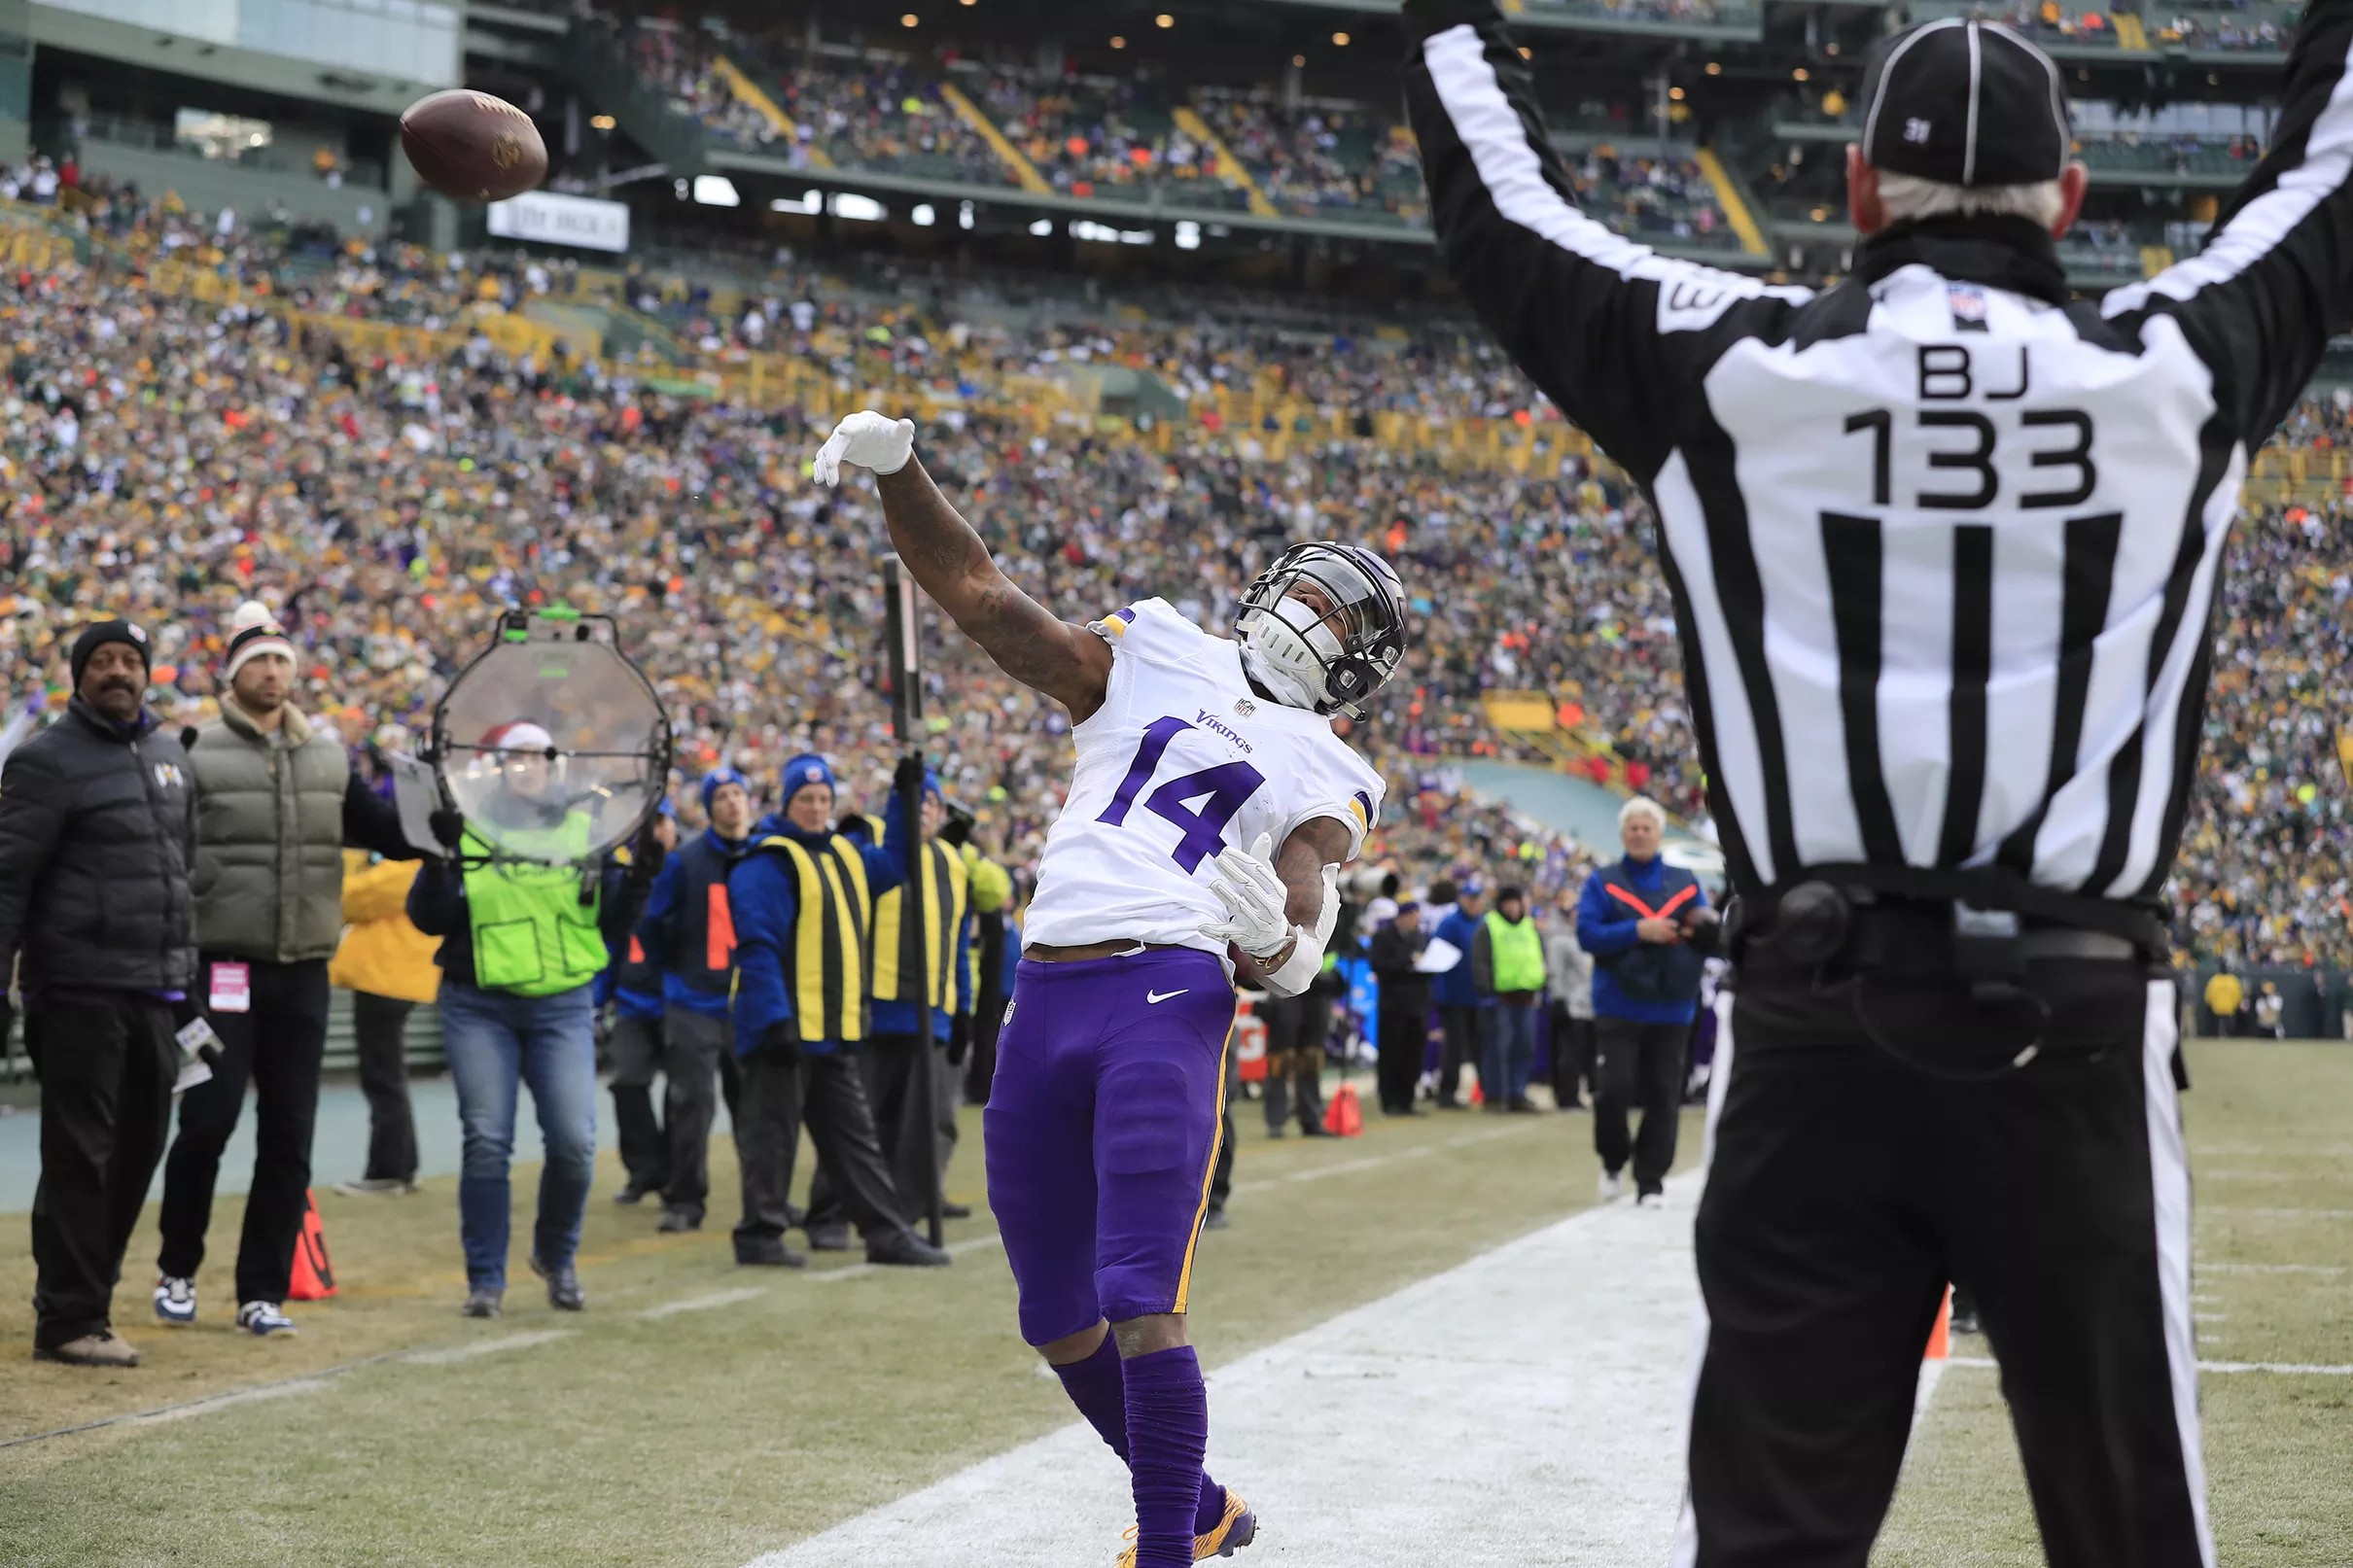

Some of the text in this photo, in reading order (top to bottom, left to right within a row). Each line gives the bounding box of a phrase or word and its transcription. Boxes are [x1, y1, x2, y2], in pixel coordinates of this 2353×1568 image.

[1917, 344, 2030, 401] BJ
[1844, 407, 2097, 509] 133
[1095, 715, 1266, 876] 14
